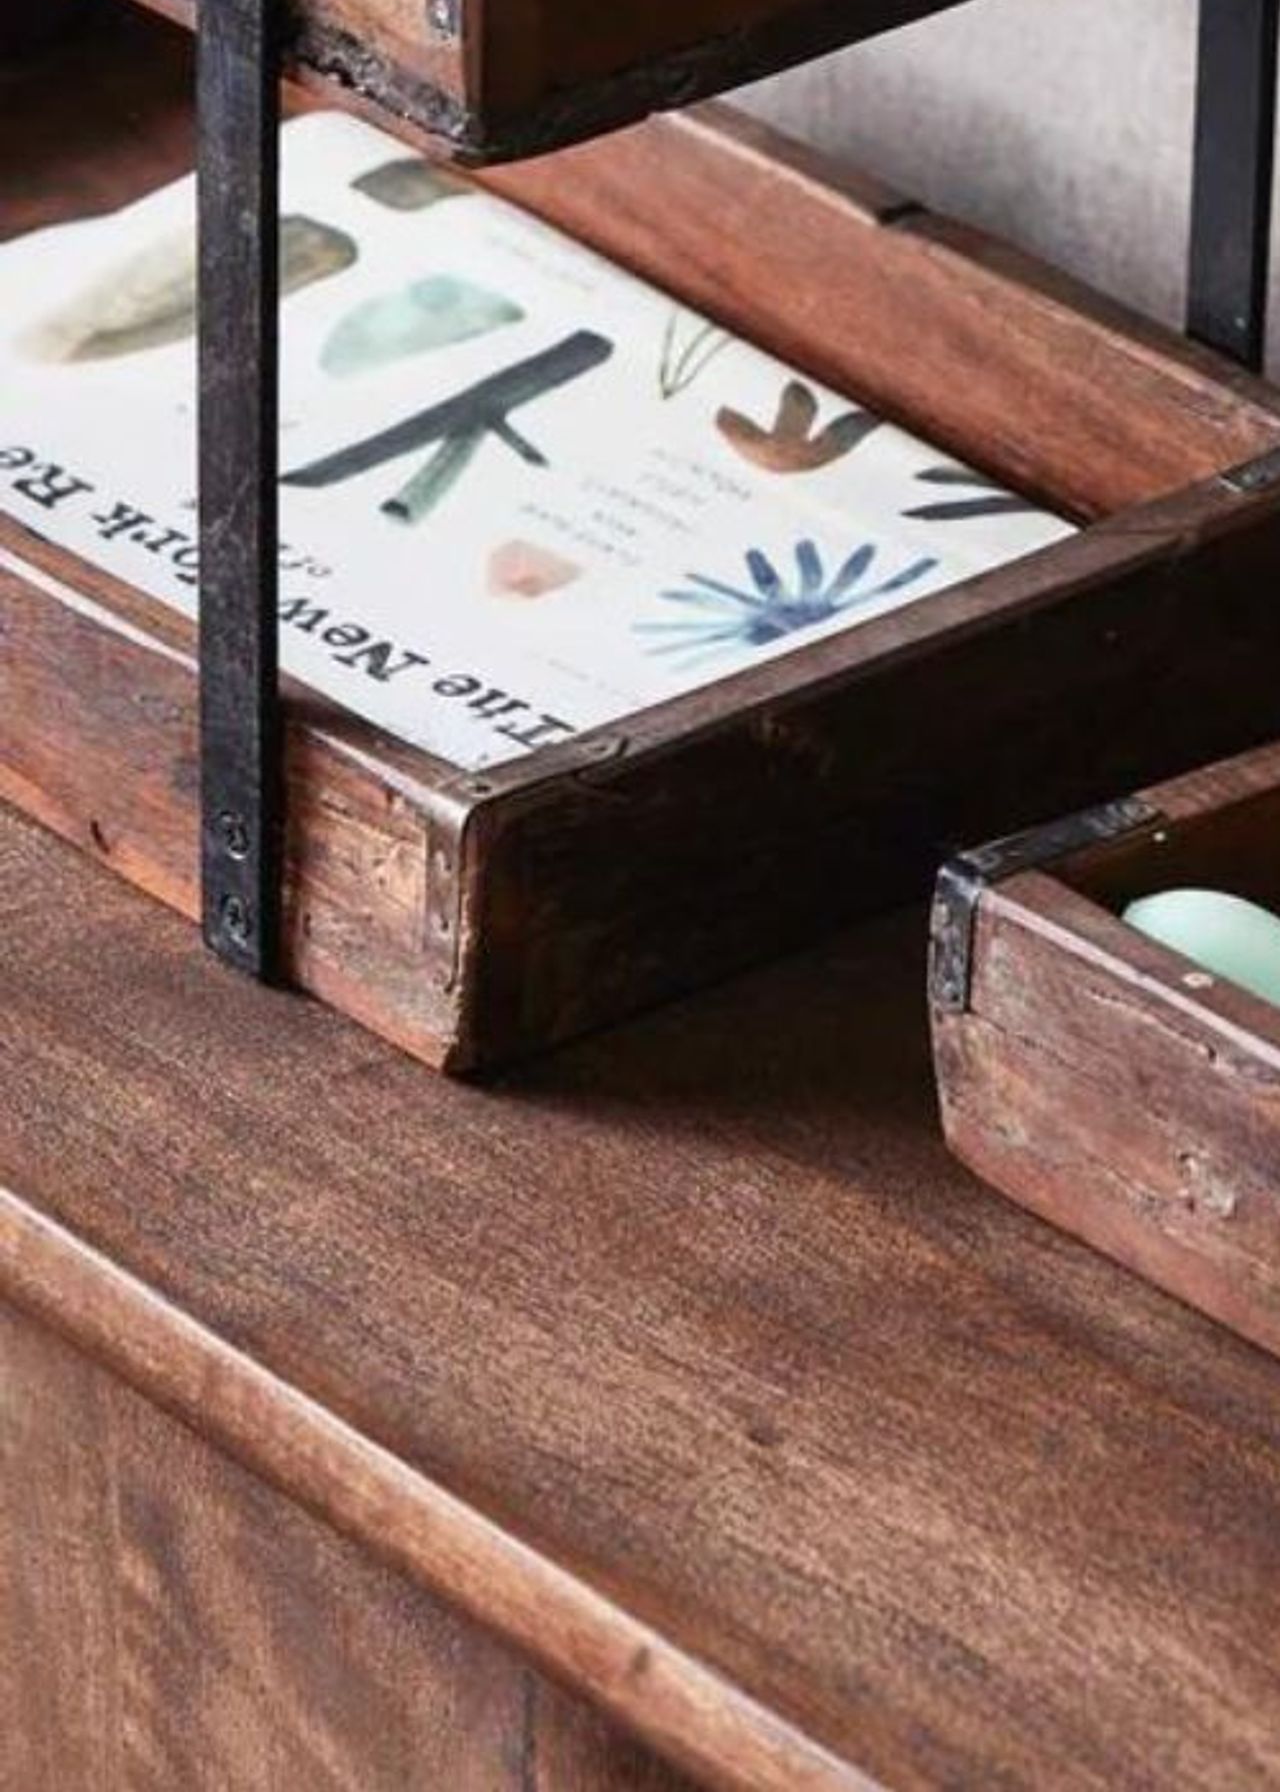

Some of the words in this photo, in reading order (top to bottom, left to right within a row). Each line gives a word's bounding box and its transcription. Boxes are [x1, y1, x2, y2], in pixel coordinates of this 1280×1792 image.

[91, 502, 199, 586] ork
[278, 597, 431, 683] New
[432, 673, 576, 749] The
